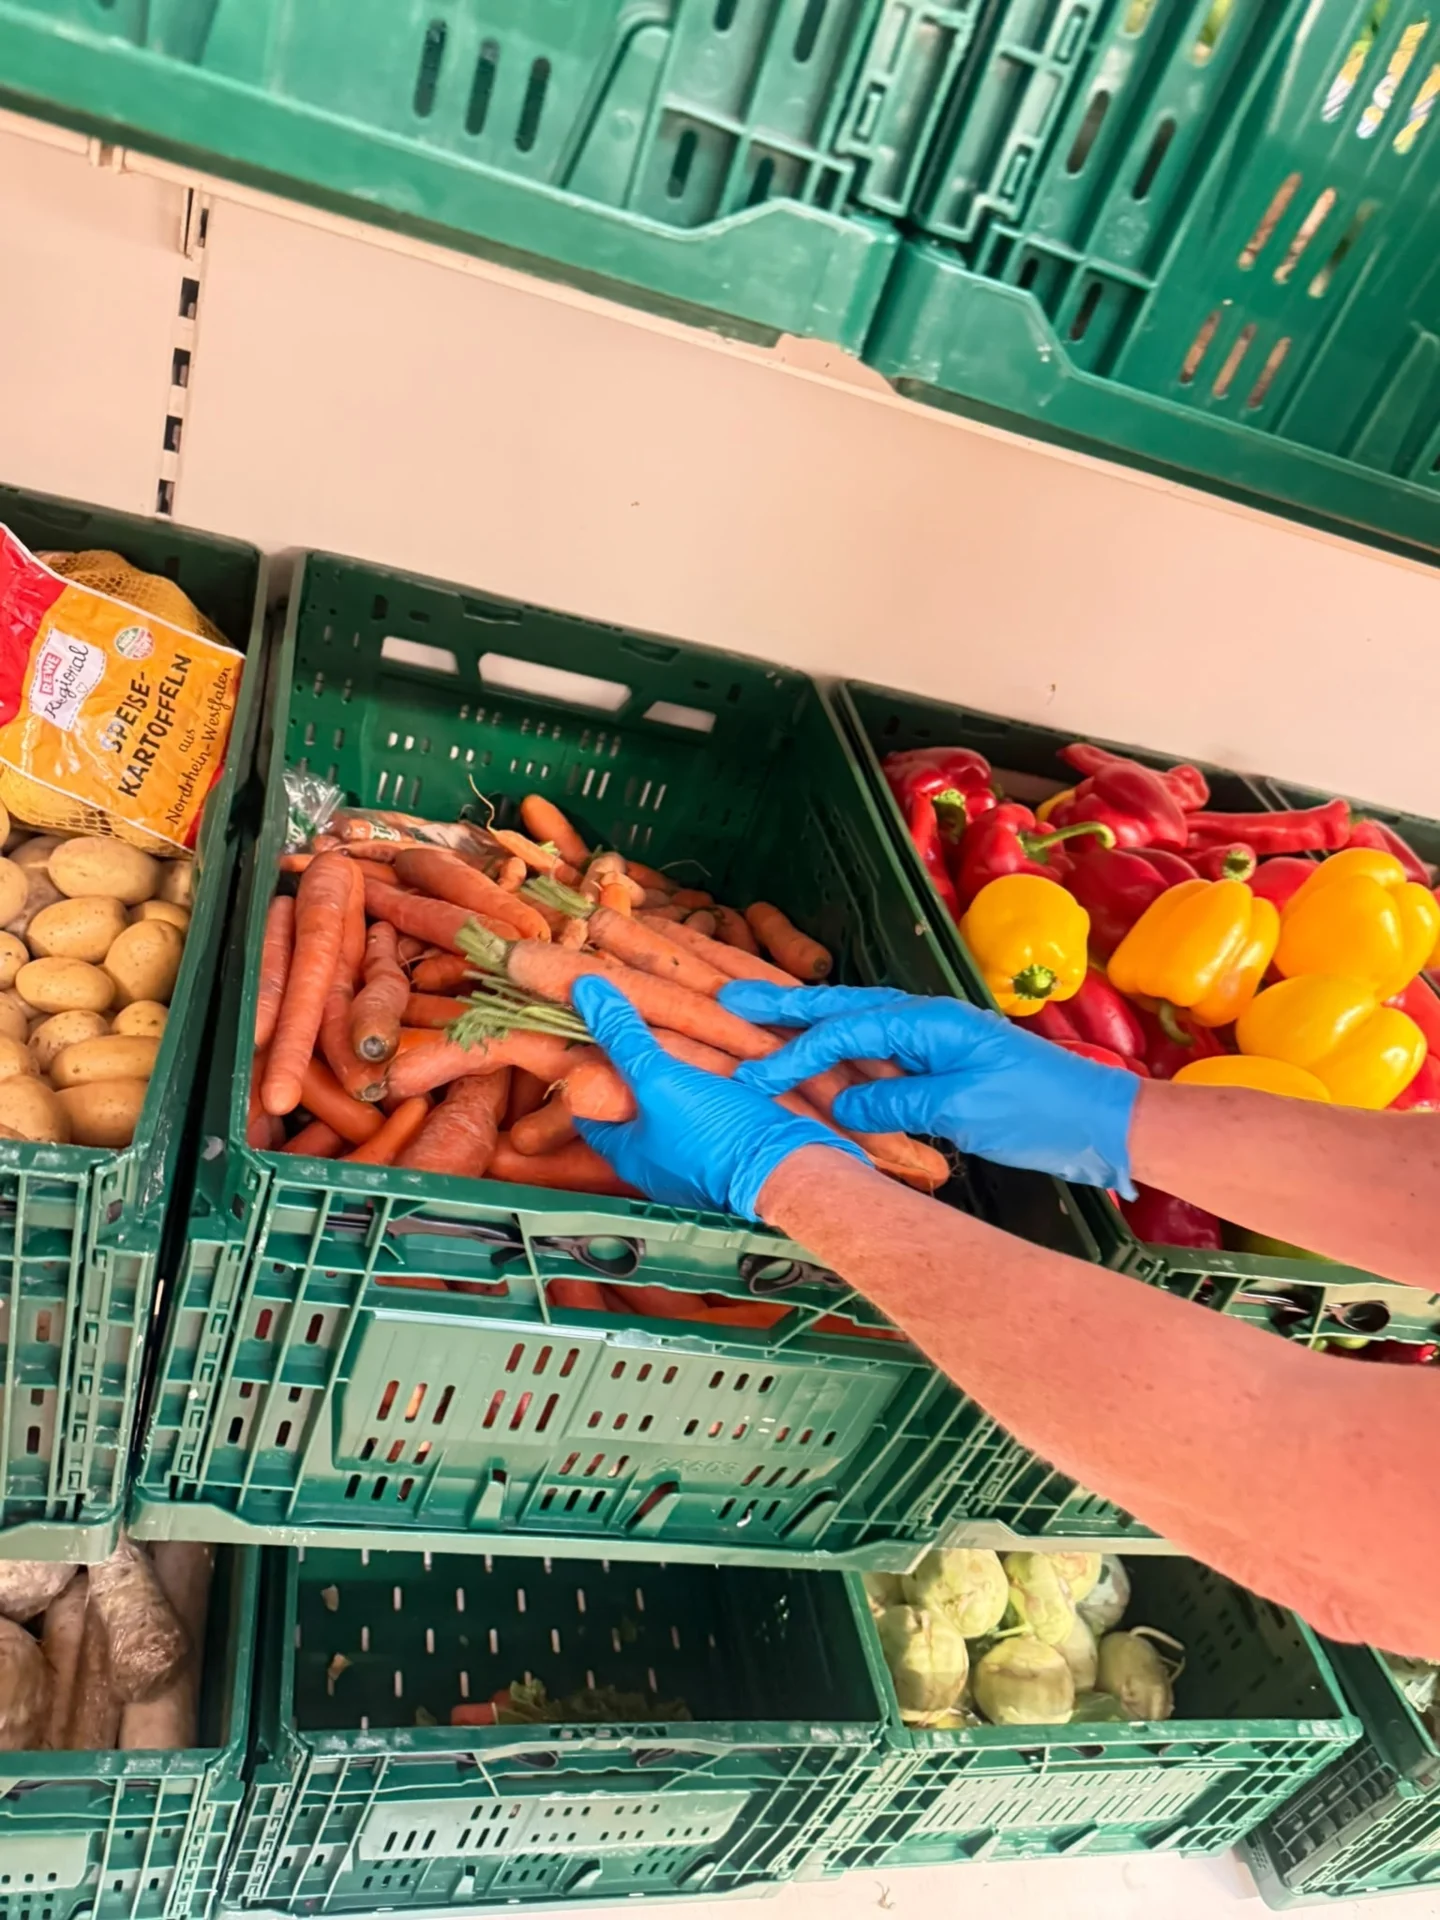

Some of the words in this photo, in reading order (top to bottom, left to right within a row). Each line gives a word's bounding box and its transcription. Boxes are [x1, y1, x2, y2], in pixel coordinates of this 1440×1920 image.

[41, 653, 61, 694] REWE
[44, 645, 89, 720] Regional
[100, 672, 151, 754] SPEISE-
[118, 653, 192, 798] KARTOFFELN
[165, 667, 232, 825] Nordrhein-Westfalen
[178, 728, 195, 753] aus
